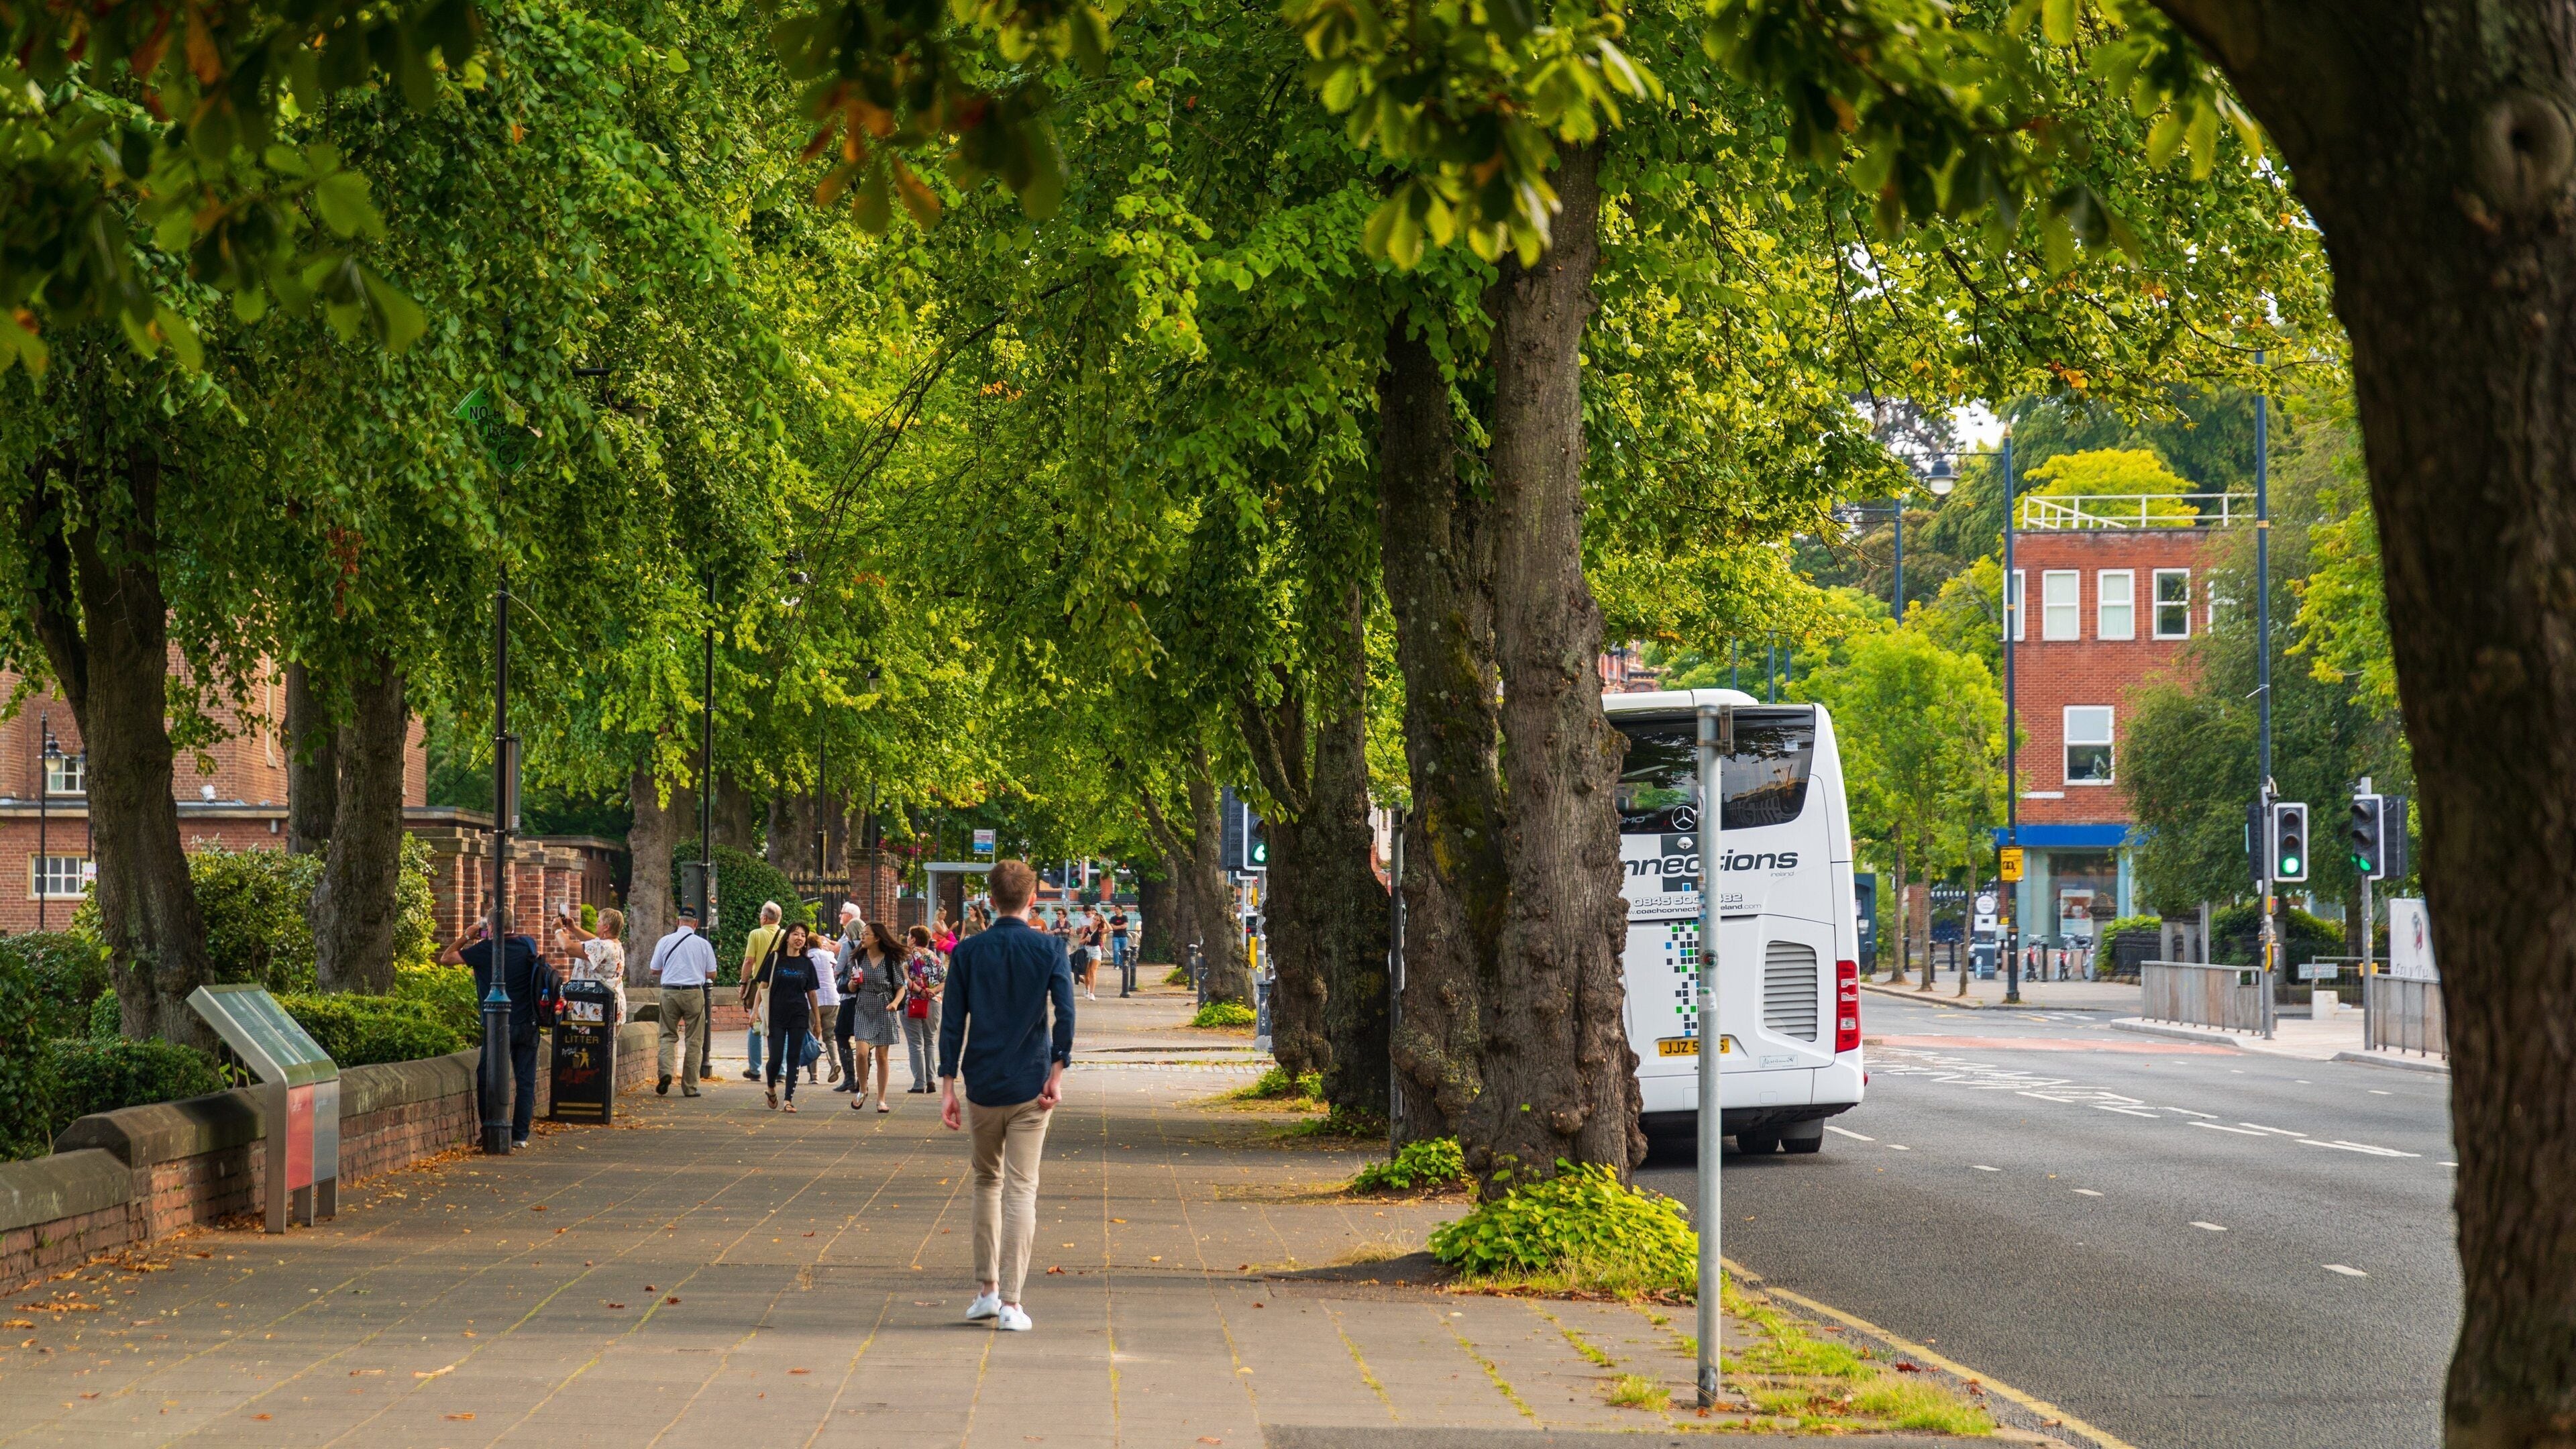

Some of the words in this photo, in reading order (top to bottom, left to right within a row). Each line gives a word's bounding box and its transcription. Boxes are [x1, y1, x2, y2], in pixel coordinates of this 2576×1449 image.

[470, 406, 488, 420] NO
[1623, 849, 1799, 876] nnecions
[1633, 896, 1672, 907] 0845
[564, 1035, 600, 1044] LITTER
[1664, 1042, 1689, 1054] JJZ
